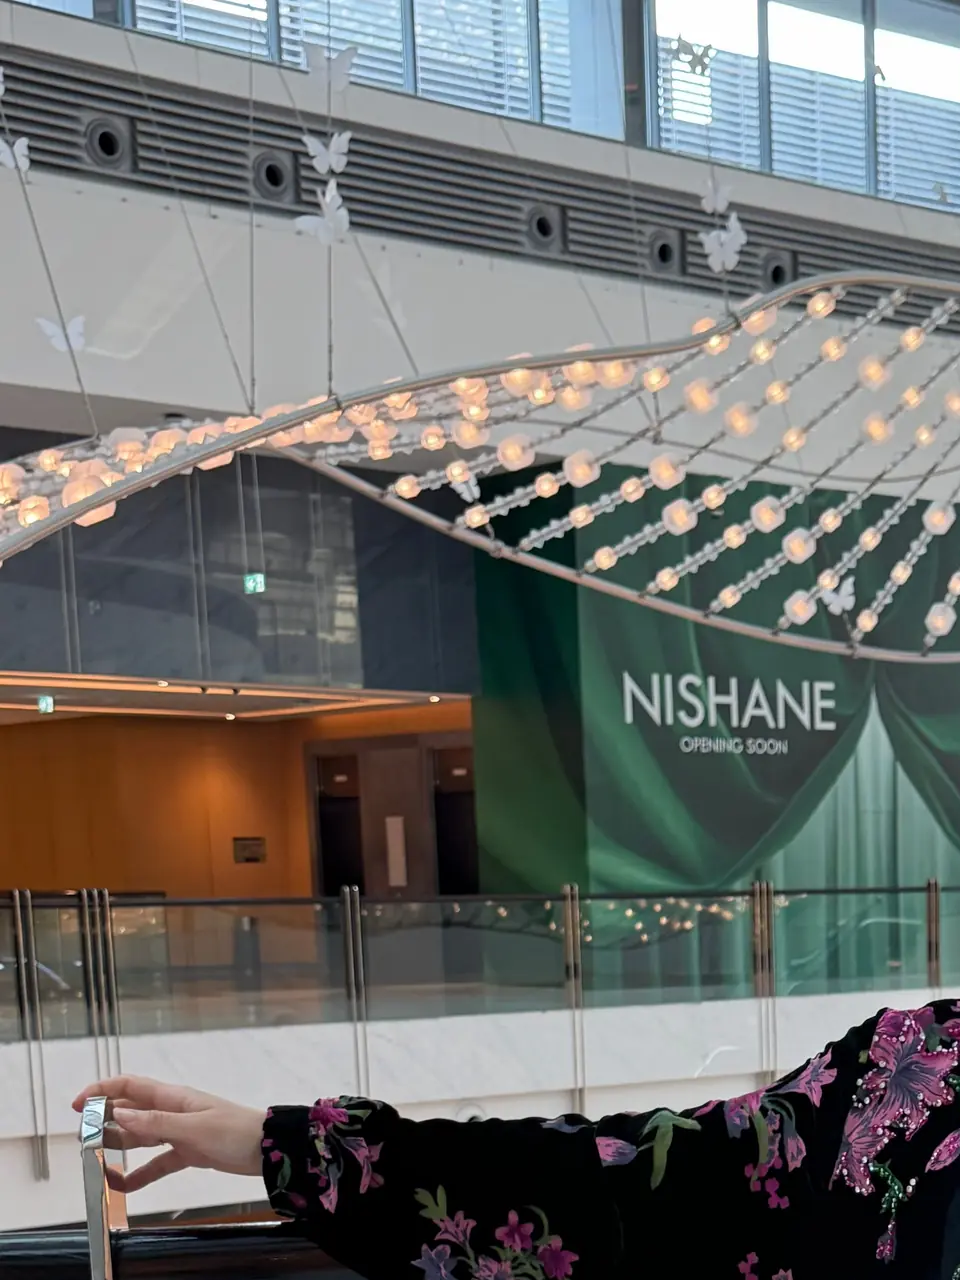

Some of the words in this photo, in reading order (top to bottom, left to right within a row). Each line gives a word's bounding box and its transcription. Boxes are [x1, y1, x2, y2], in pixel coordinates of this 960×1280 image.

[622, 671, 836, 731] NISHANE
[680, 736, 744, 754] OPENING
[746, 739, 788, 755] SOON
